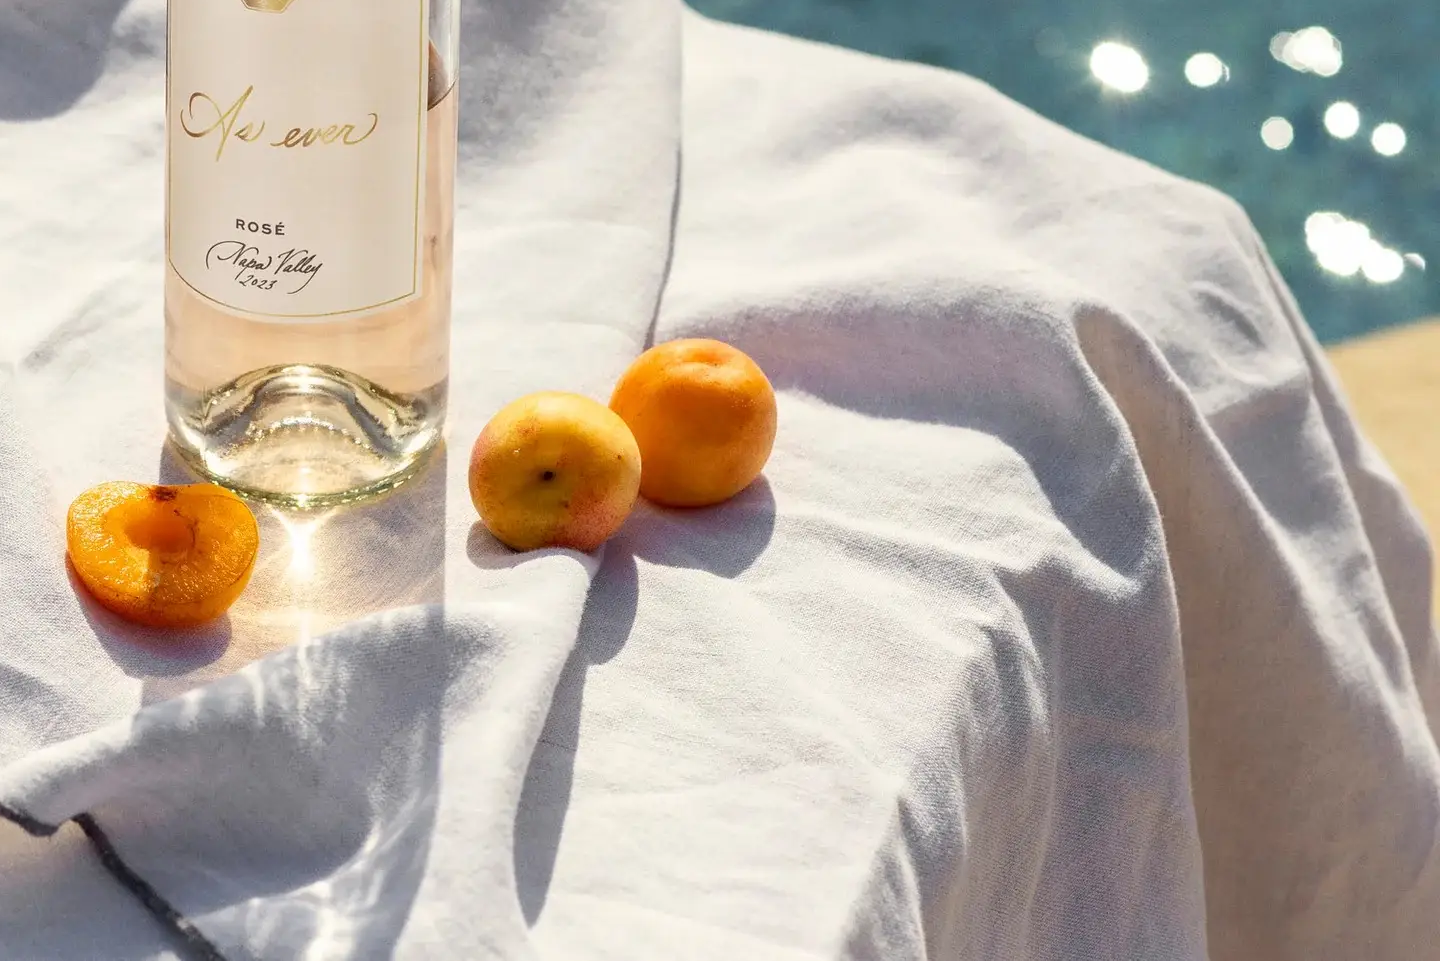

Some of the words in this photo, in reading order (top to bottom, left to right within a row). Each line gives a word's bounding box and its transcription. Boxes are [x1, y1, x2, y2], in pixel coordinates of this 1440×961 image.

[180, 85, 265, 162] As
[270, 113, 378, 148] ever
[235, 218, 285, 236] ROSÉ
[206, 240, 272, 281] Napa
[274, 248, 324, 295] Valley
[239, 274, 277, 290] 2023
